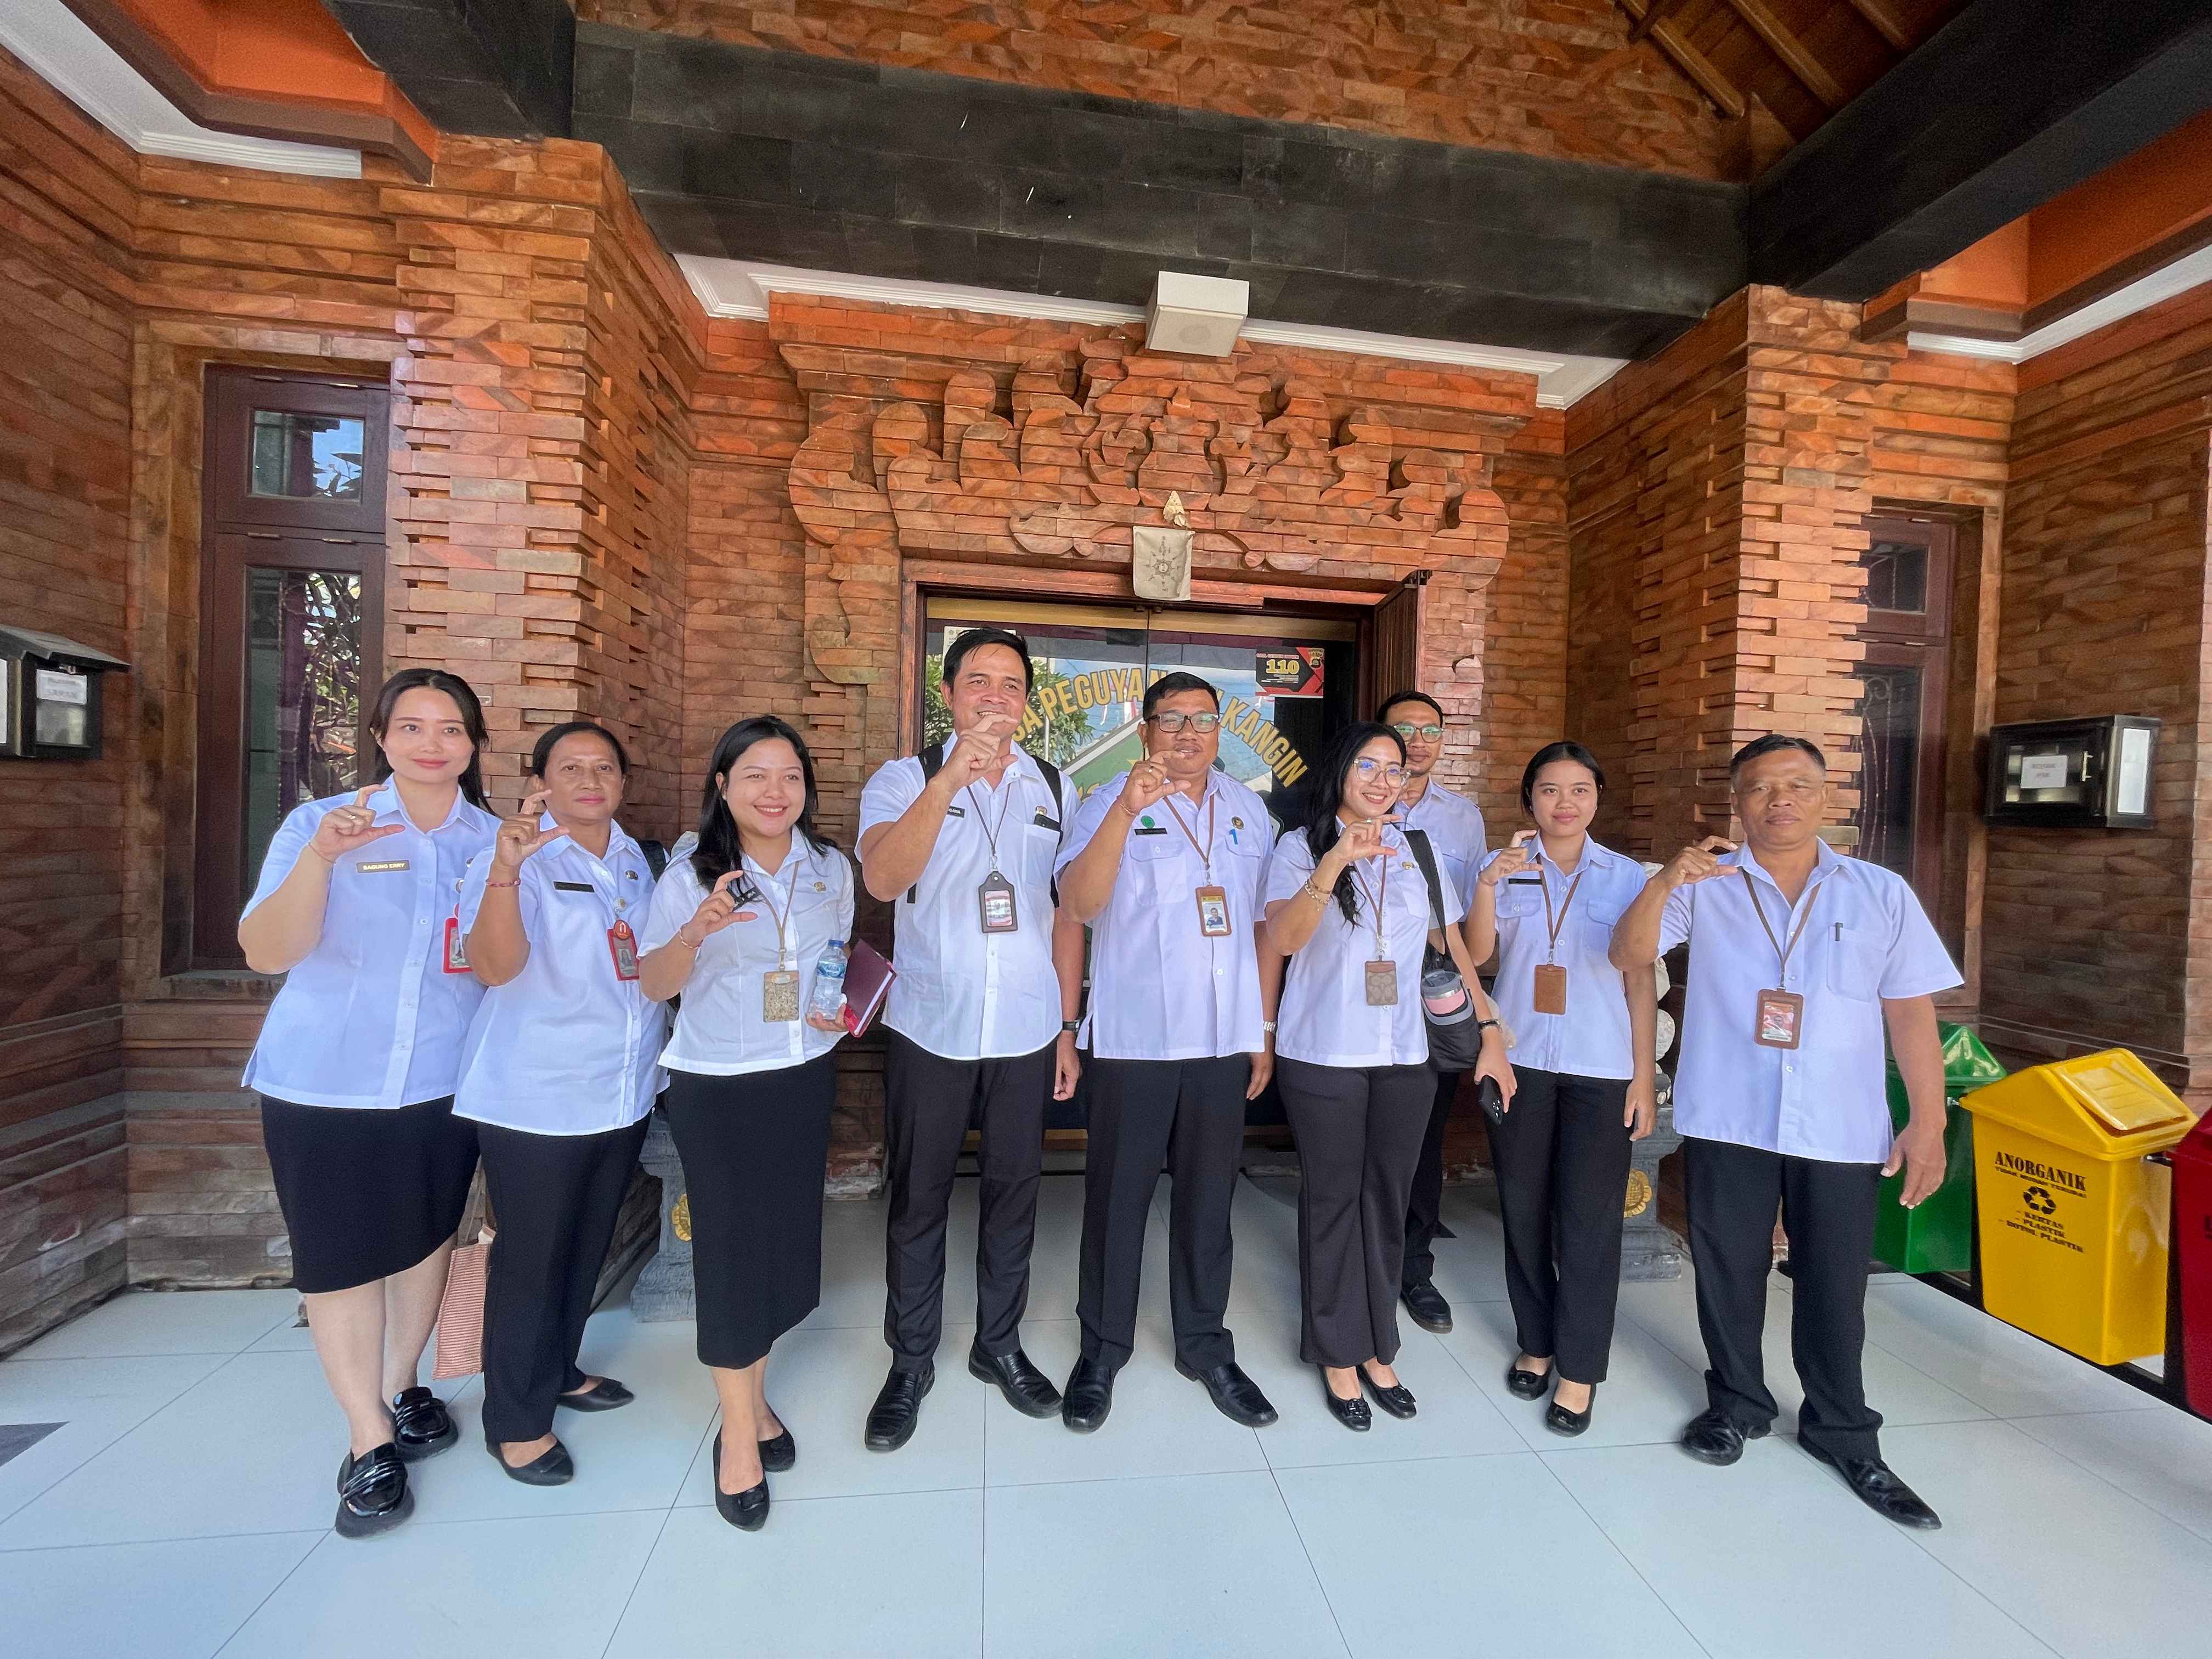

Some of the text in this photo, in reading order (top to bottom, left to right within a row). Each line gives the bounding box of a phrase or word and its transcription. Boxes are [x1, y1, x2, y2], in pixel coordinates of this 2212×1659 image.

[1266, 659, 1300, 674] 110
[1220, 696, 1308, 788] KANGIN
[1995, 1151, 2086, 1192] ANORGANIK
